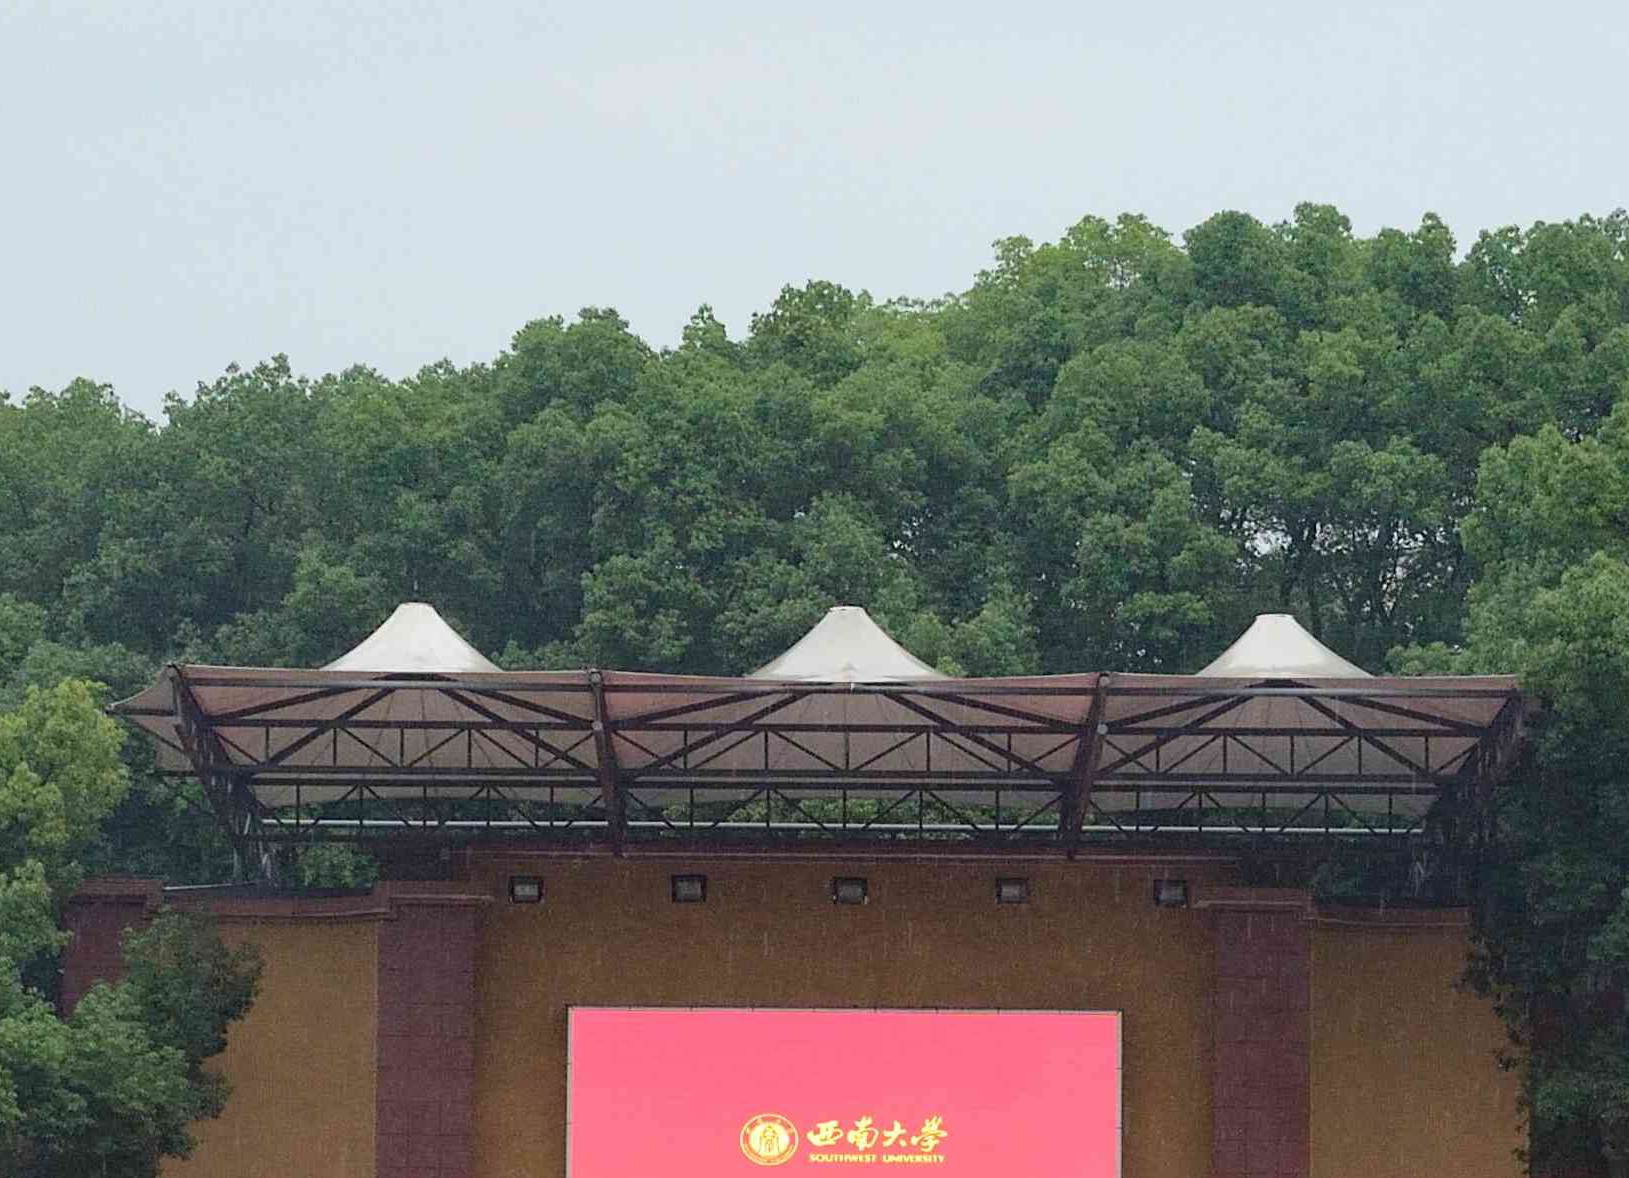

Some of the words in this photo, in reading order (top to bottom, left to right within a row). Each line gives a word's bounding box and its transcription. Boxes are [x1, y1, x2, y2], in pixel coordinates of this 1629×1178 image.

[806, 1115, 948, 1152] 西南大学
[882, 1153, 946, 1164] UNIVERSITY
